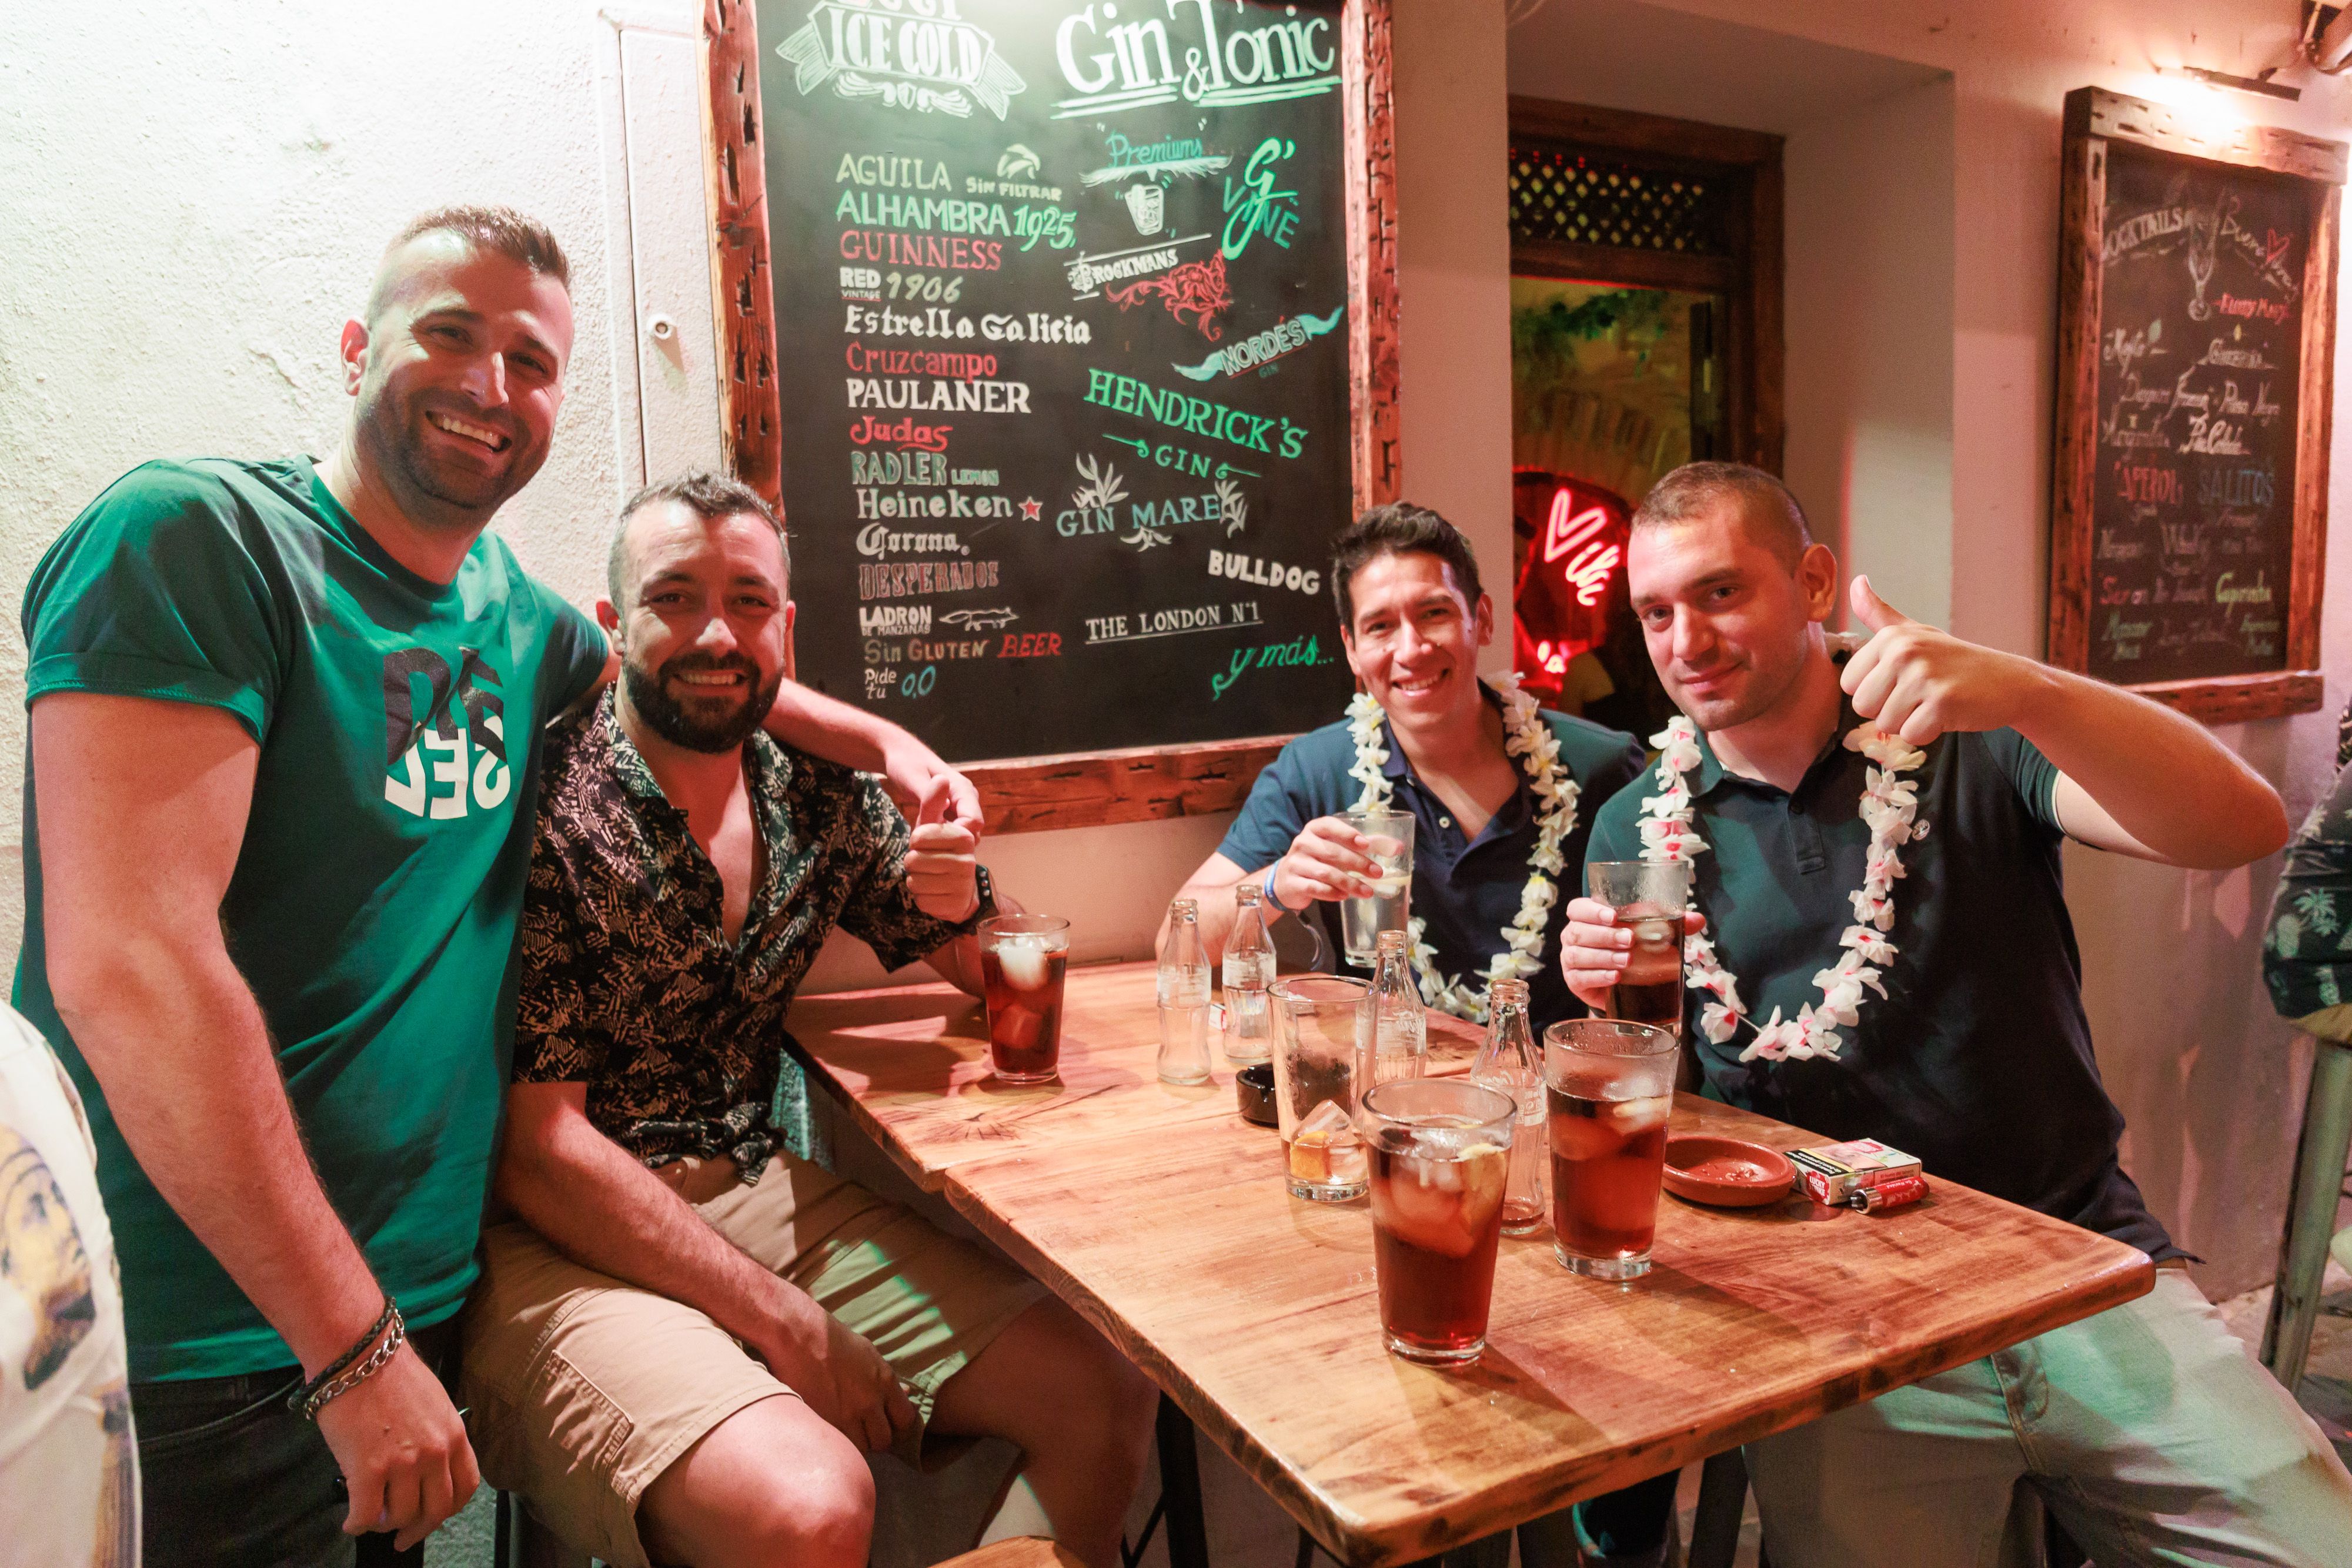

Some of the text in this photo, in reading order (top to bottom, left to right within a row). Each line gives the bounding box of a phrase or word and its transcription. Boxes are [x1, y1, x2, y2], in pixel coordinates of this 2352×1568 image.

[827, 7, 982, 82] ICE COLD
[1056, 0, 1335, 101] Gin & Tonic
[836, 153, 952, 192] AGUILA
[1000, 182, 1063, 202] FILTRAR
[836, 189, 1011, 237] ALHAMBRA
[840, 229, 1003, 271] GUINNESS
[840, 267, 964, 304] RED 1906
[841, 289, 881, 300] VINTAGE
[845, 304, 1092, 345] Estrella Galicia
[846, 341, 997, 384] Cruzcampo
[846, 377, 1031, 413] PAULANER
[1083, 367, 1308, 459] HENDRICK'S
[850, 415, 954, 452] Judas
[851, 451, 947, 486] RADLER
[1155, 445, 1211, 479] GIN
[856, 488, 1014, 519] Heineken
[1057, 494, 1222, 537] GIN MARE
[859, 561, 998, 600] DESPERADOS
[1208, 549, 1321, 596] BULLDOG
[859, 605, 932, 627] LADRON
[1085, 616, 1128, 640] THE
[1139, 606, 1220, 633] LONDON
[864, 639, 901, 664] Sin
[997, 632, 1062, 658] BEER
[865, 667, 897, 684] Pide
[866, 684, 886, 699] tu
[1212, 647, 1257, 701] y
[1809, 1176, 1825, 1189] LUCKY
